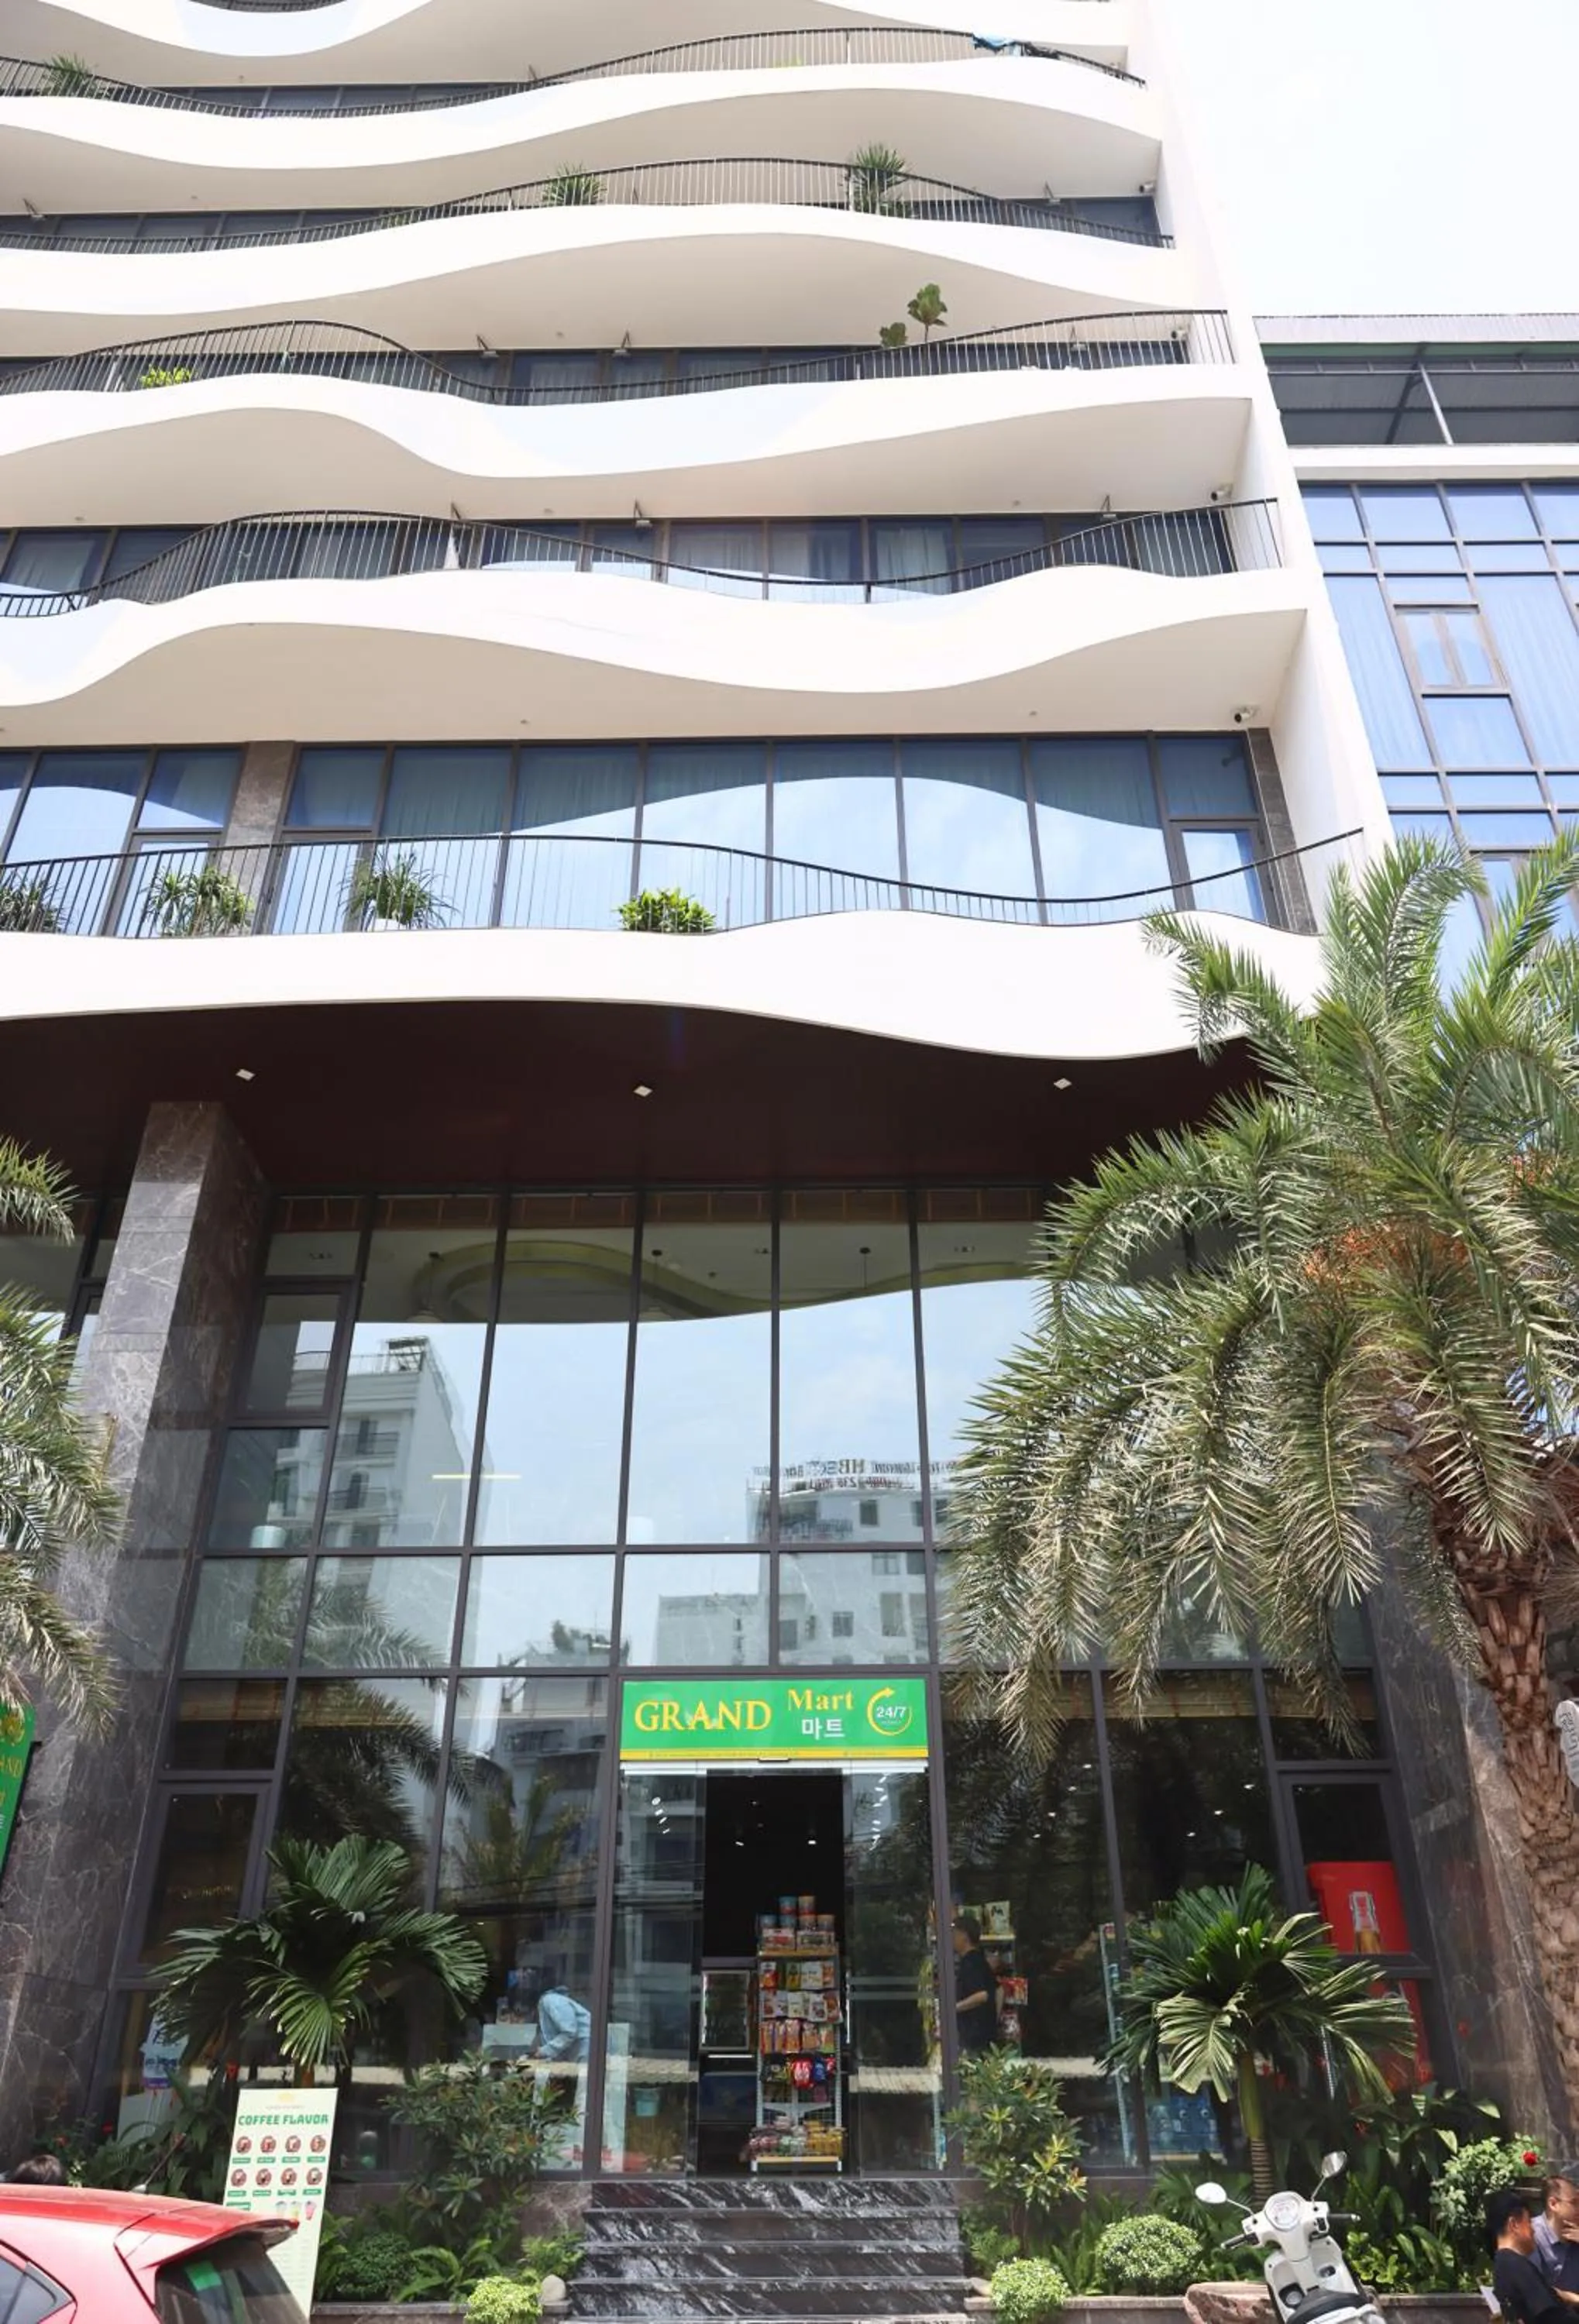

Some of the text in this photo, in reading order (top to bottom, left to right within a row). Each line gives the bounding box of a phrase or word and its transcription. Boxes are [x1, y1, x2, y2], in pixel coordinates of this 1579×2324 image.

[634, 1688, 854, 1732] GRAND Mart
[876, 1706, 906, 1718] 24/7
[801, 1717, 846, 1741] 마트
[238, 2113, 329, 2126] COFFEE FLAVOR
